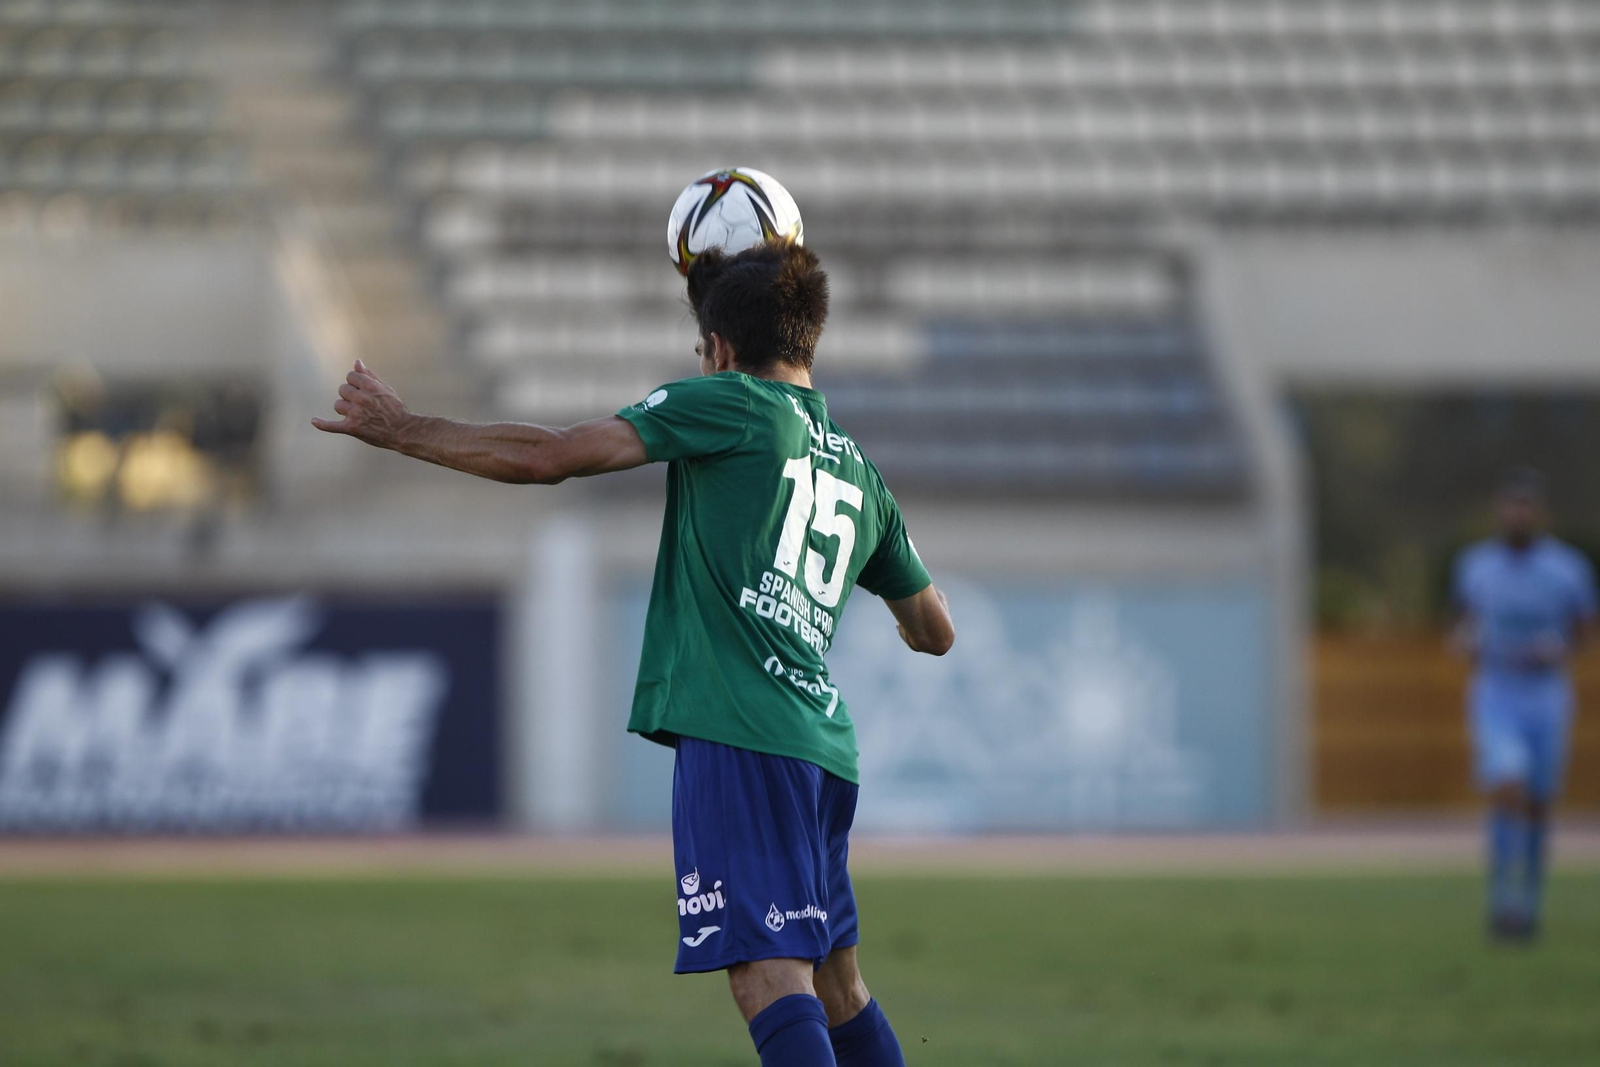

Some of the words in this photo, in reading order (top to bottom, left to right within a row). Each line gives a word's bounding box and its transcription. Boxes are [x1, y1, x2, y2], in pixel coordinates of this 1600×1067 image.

[773, 455, 863, 608] 15
[759, 571, 811, 621] SPANISH
[813, 605, 834, 637] PRO
